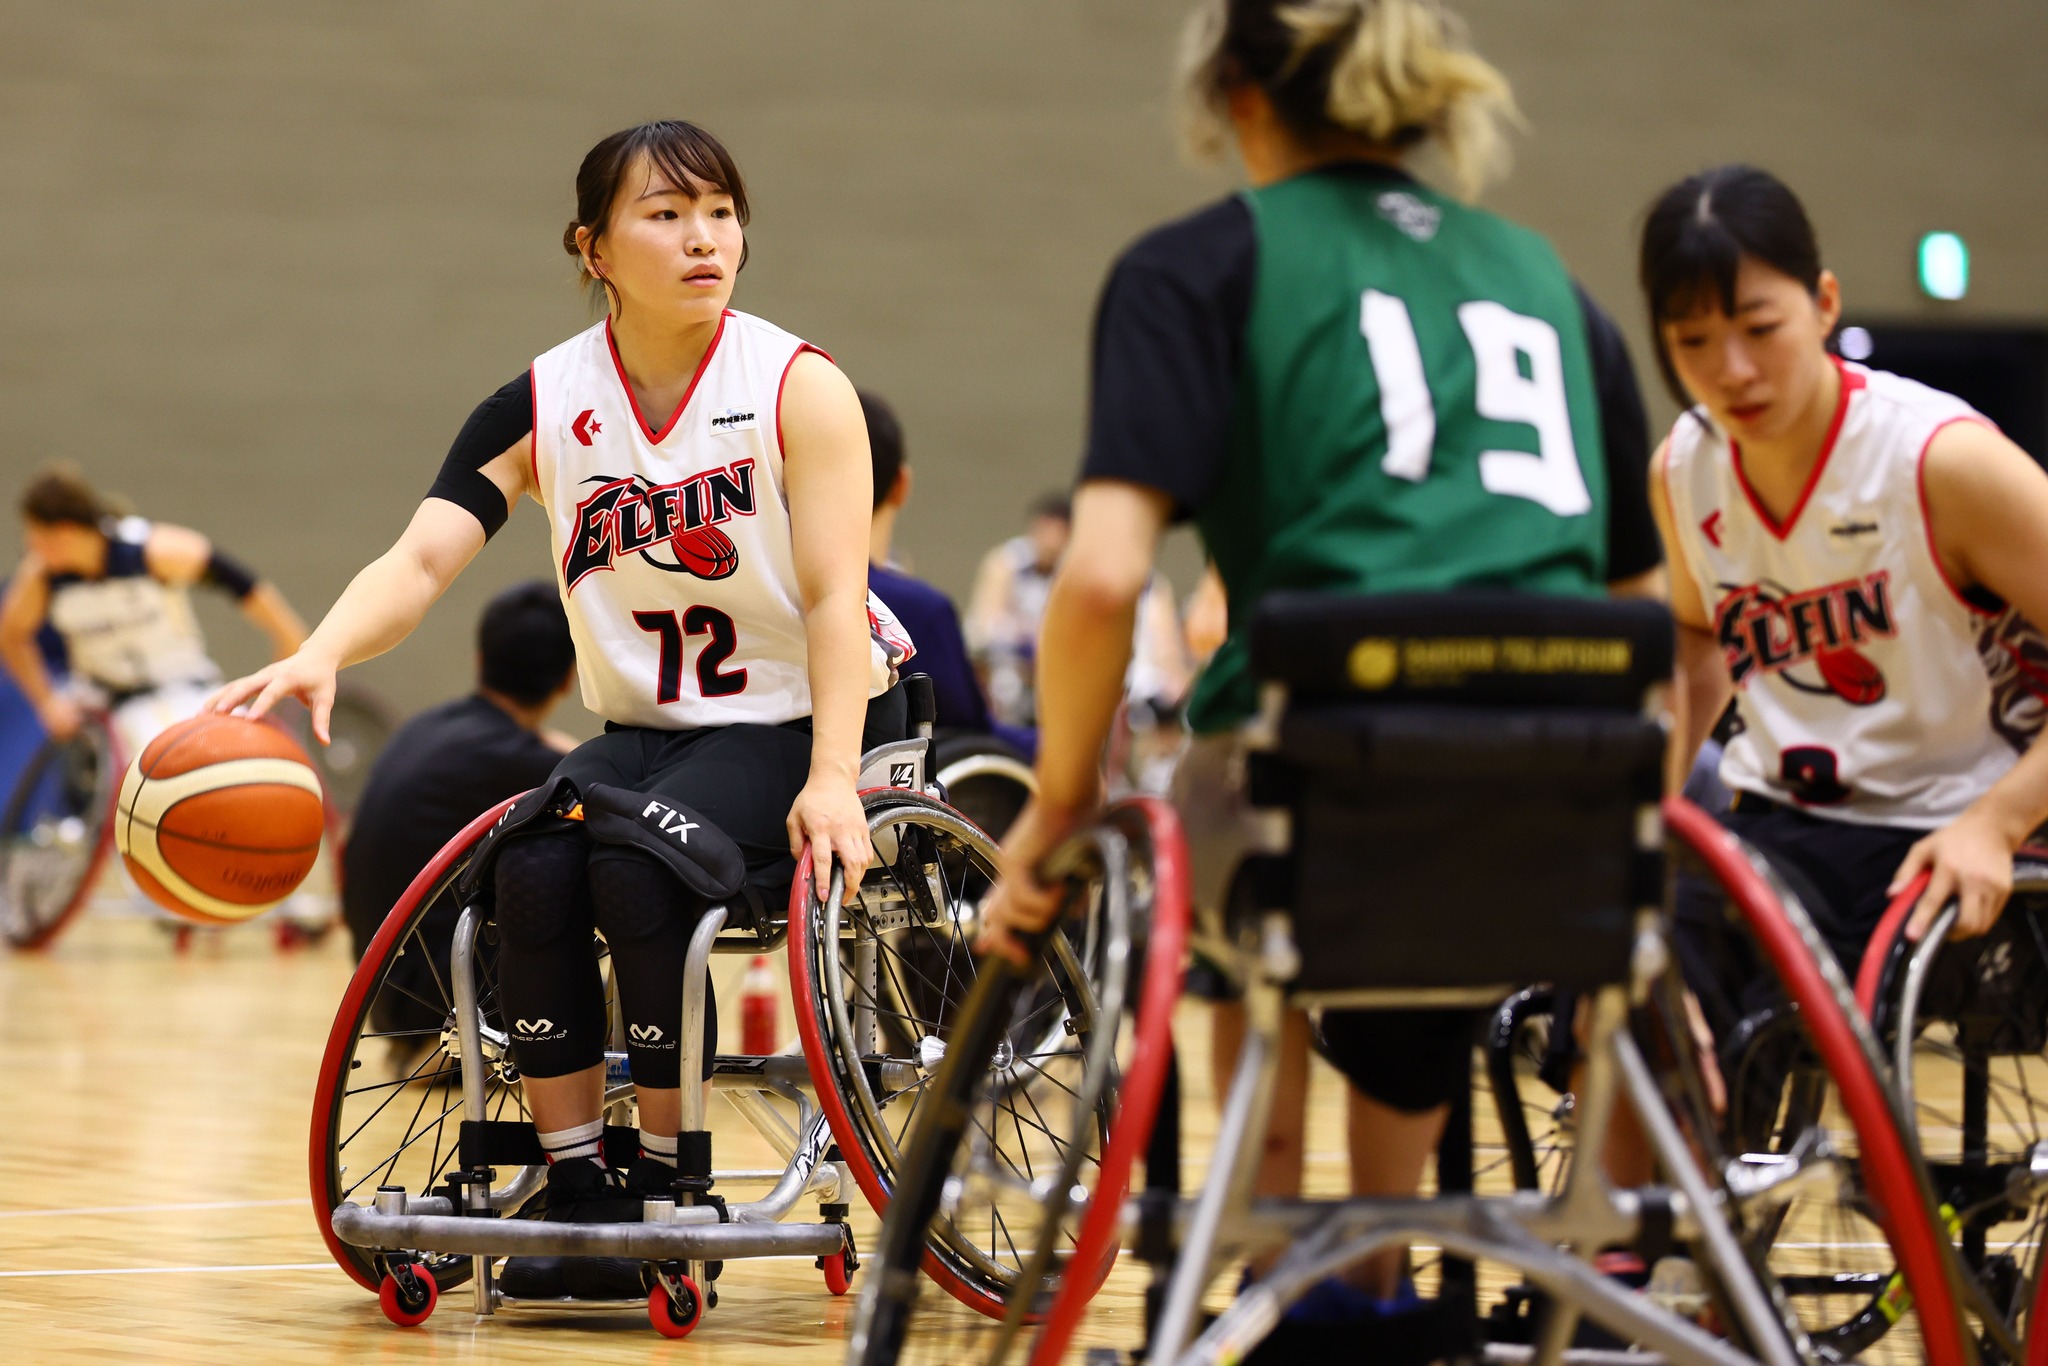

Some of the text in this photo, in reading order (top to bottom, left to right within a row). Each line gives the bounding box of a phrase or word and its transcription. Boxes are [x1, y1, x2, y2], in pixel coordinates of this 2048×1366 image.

[1359, 287, 1593, 517] 19
[562, 457, 756, 600] ELFIN
[631, 604, 748, 705] 72
[1714, 569, 1898, 691] ELFIN
[641, 800, 701, 845] FIX
